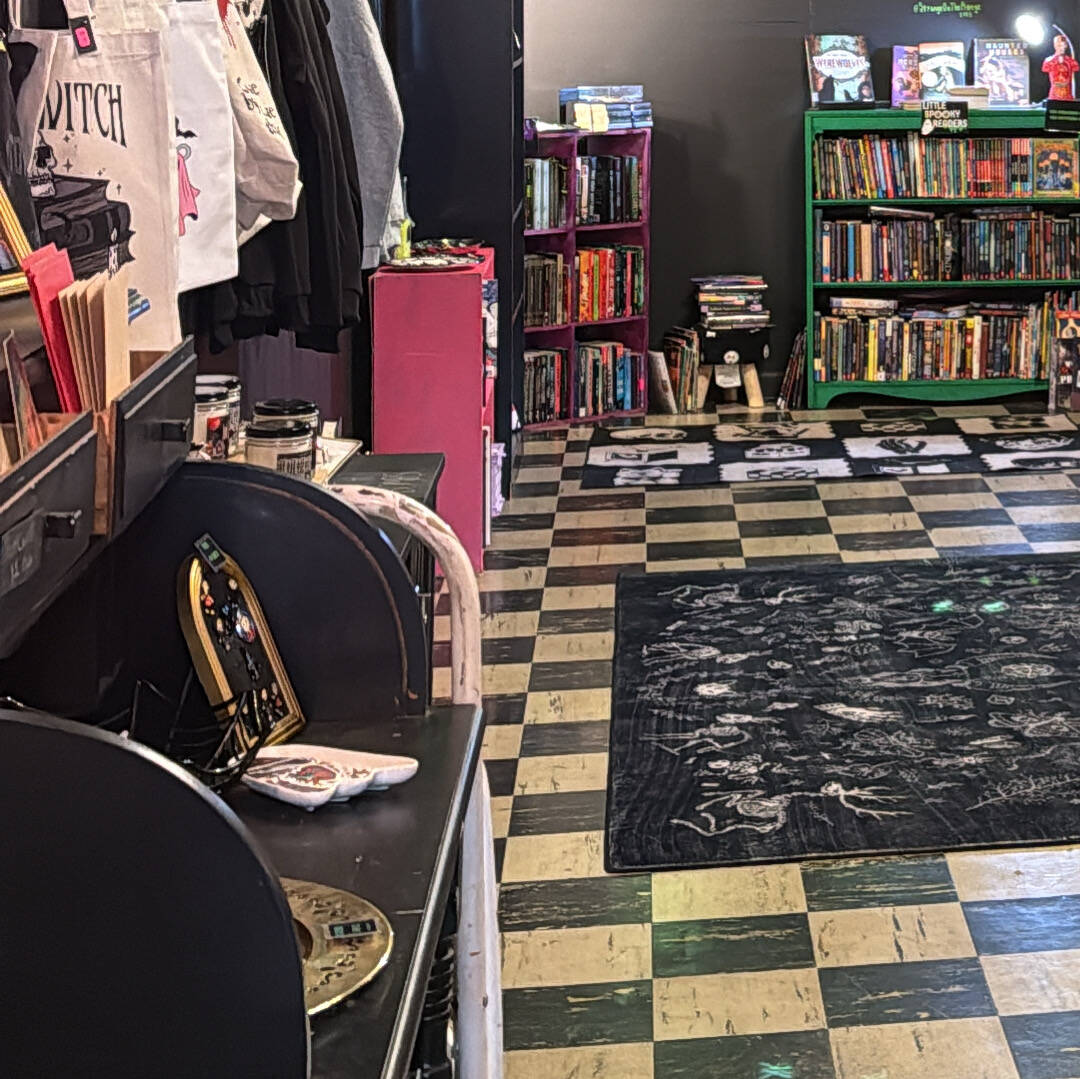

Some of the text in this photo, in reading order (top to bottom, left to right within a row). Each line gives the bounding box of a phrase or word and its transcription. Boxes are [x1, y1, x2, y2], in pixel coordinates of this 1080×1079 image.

[923, 101, 947, 110] LITTLE
[924, 110, 960, 119] SPOOKY
[932, 119, 968, 128] READERS
